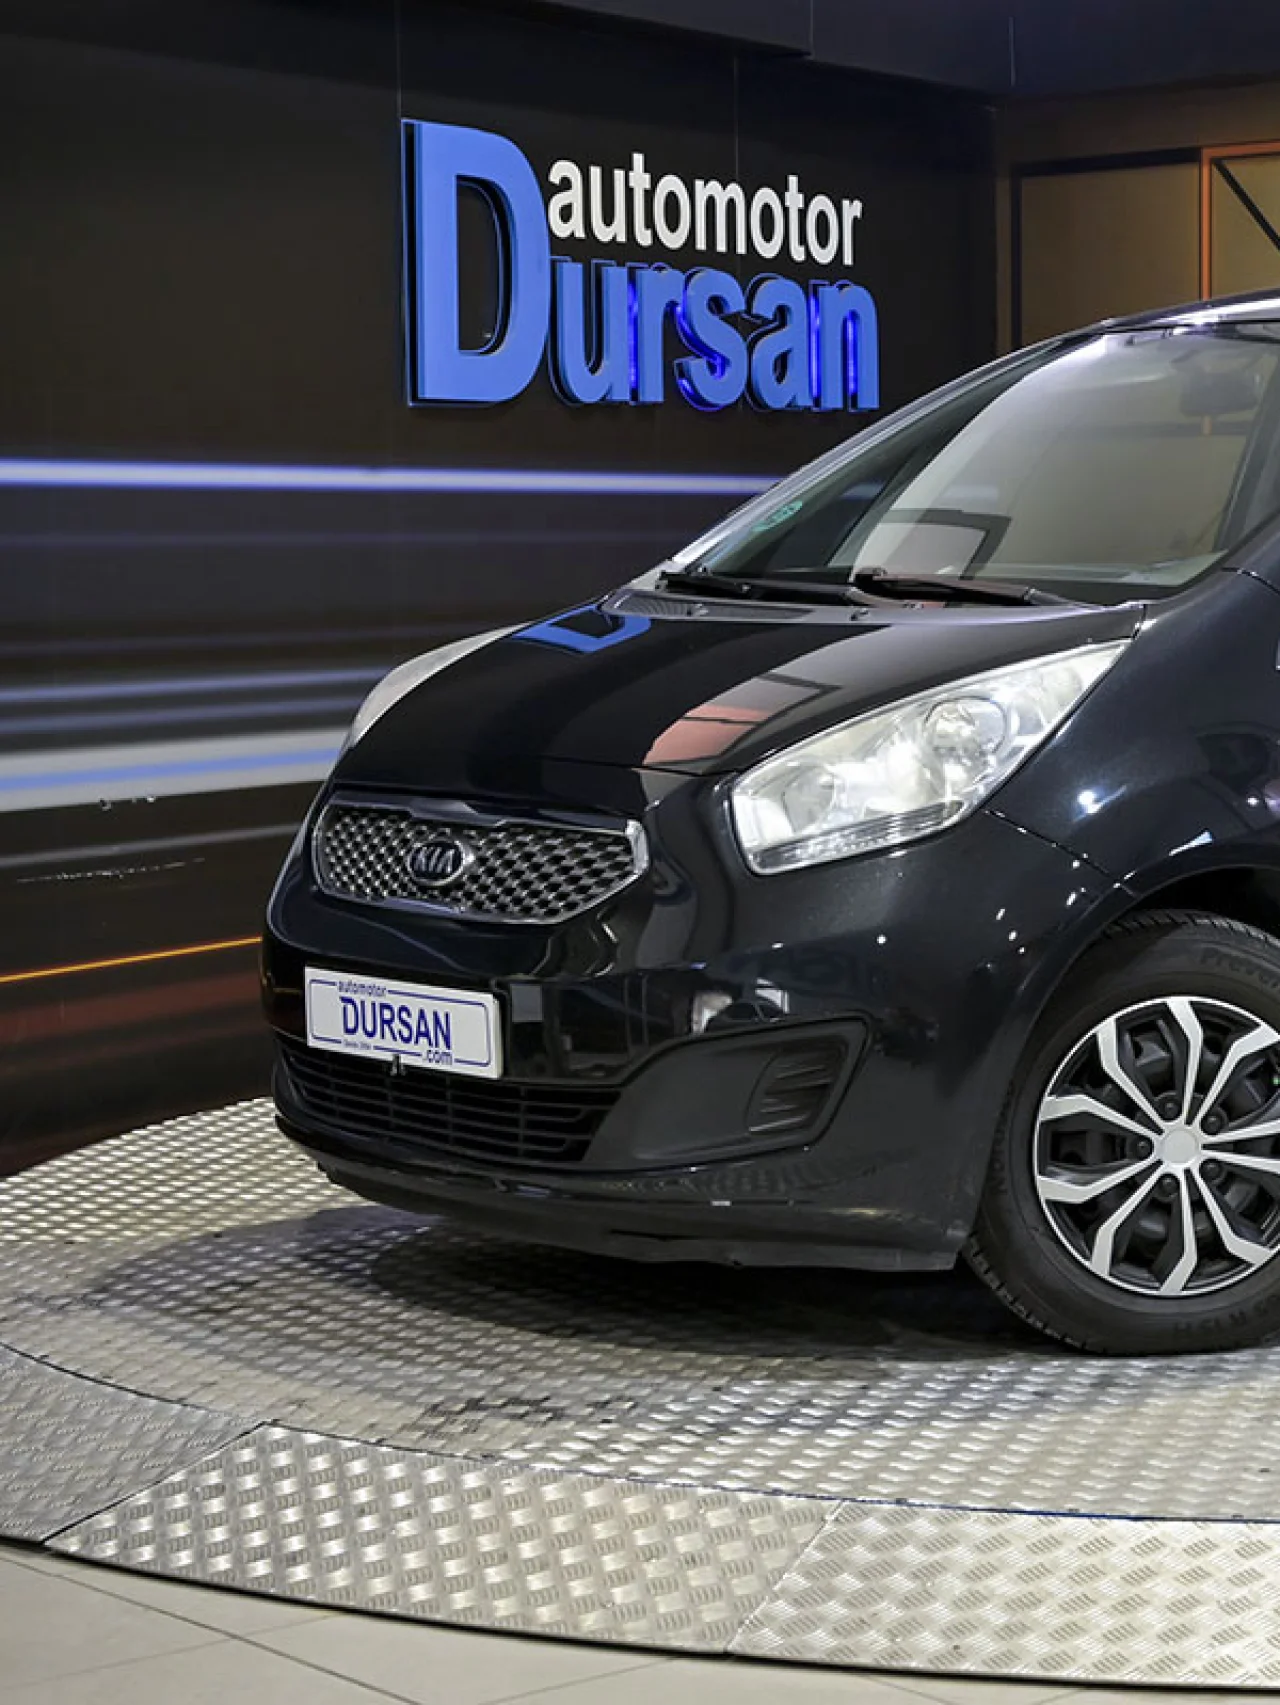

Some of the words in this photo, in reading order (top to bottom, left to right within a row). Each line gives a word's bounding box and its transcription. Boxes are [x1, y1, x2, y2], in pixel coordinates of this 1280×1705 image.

[548, 152, 863, 265] automotor
[401, 118, 881, 413] Dursan
[413, 846, 456, 874] KIA
[339, 996, 452, 1050] DURSAN
